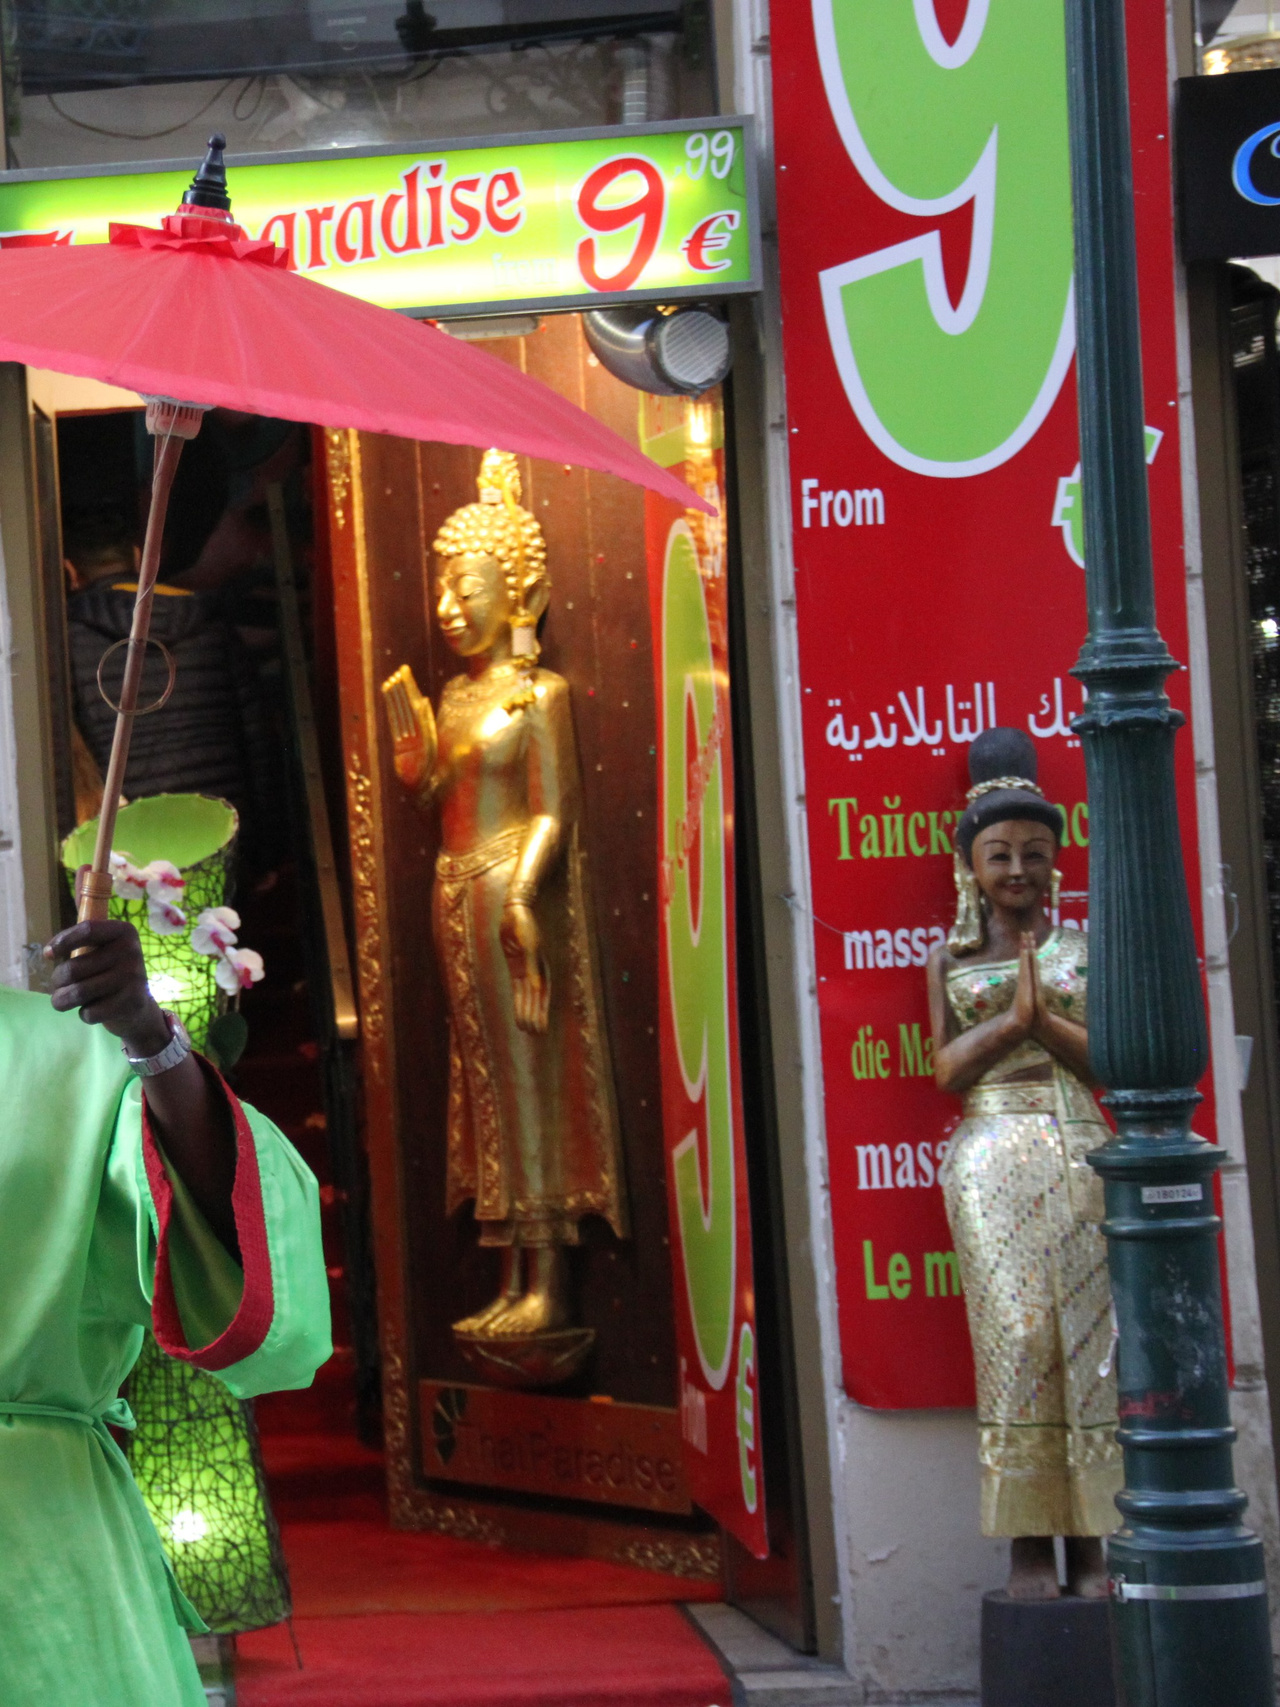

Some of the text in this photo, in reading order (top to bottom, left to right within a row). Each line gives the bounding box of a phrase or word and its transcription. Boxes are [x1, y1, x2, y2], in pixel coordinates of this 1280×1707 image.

[237, 158, 526, 272] aradise
[680, 210, 741, 274] €
[801, 479, 886, 528] From
[851, 1025, 891, 1080] die
[863, 1240, 912, 1300] Le
